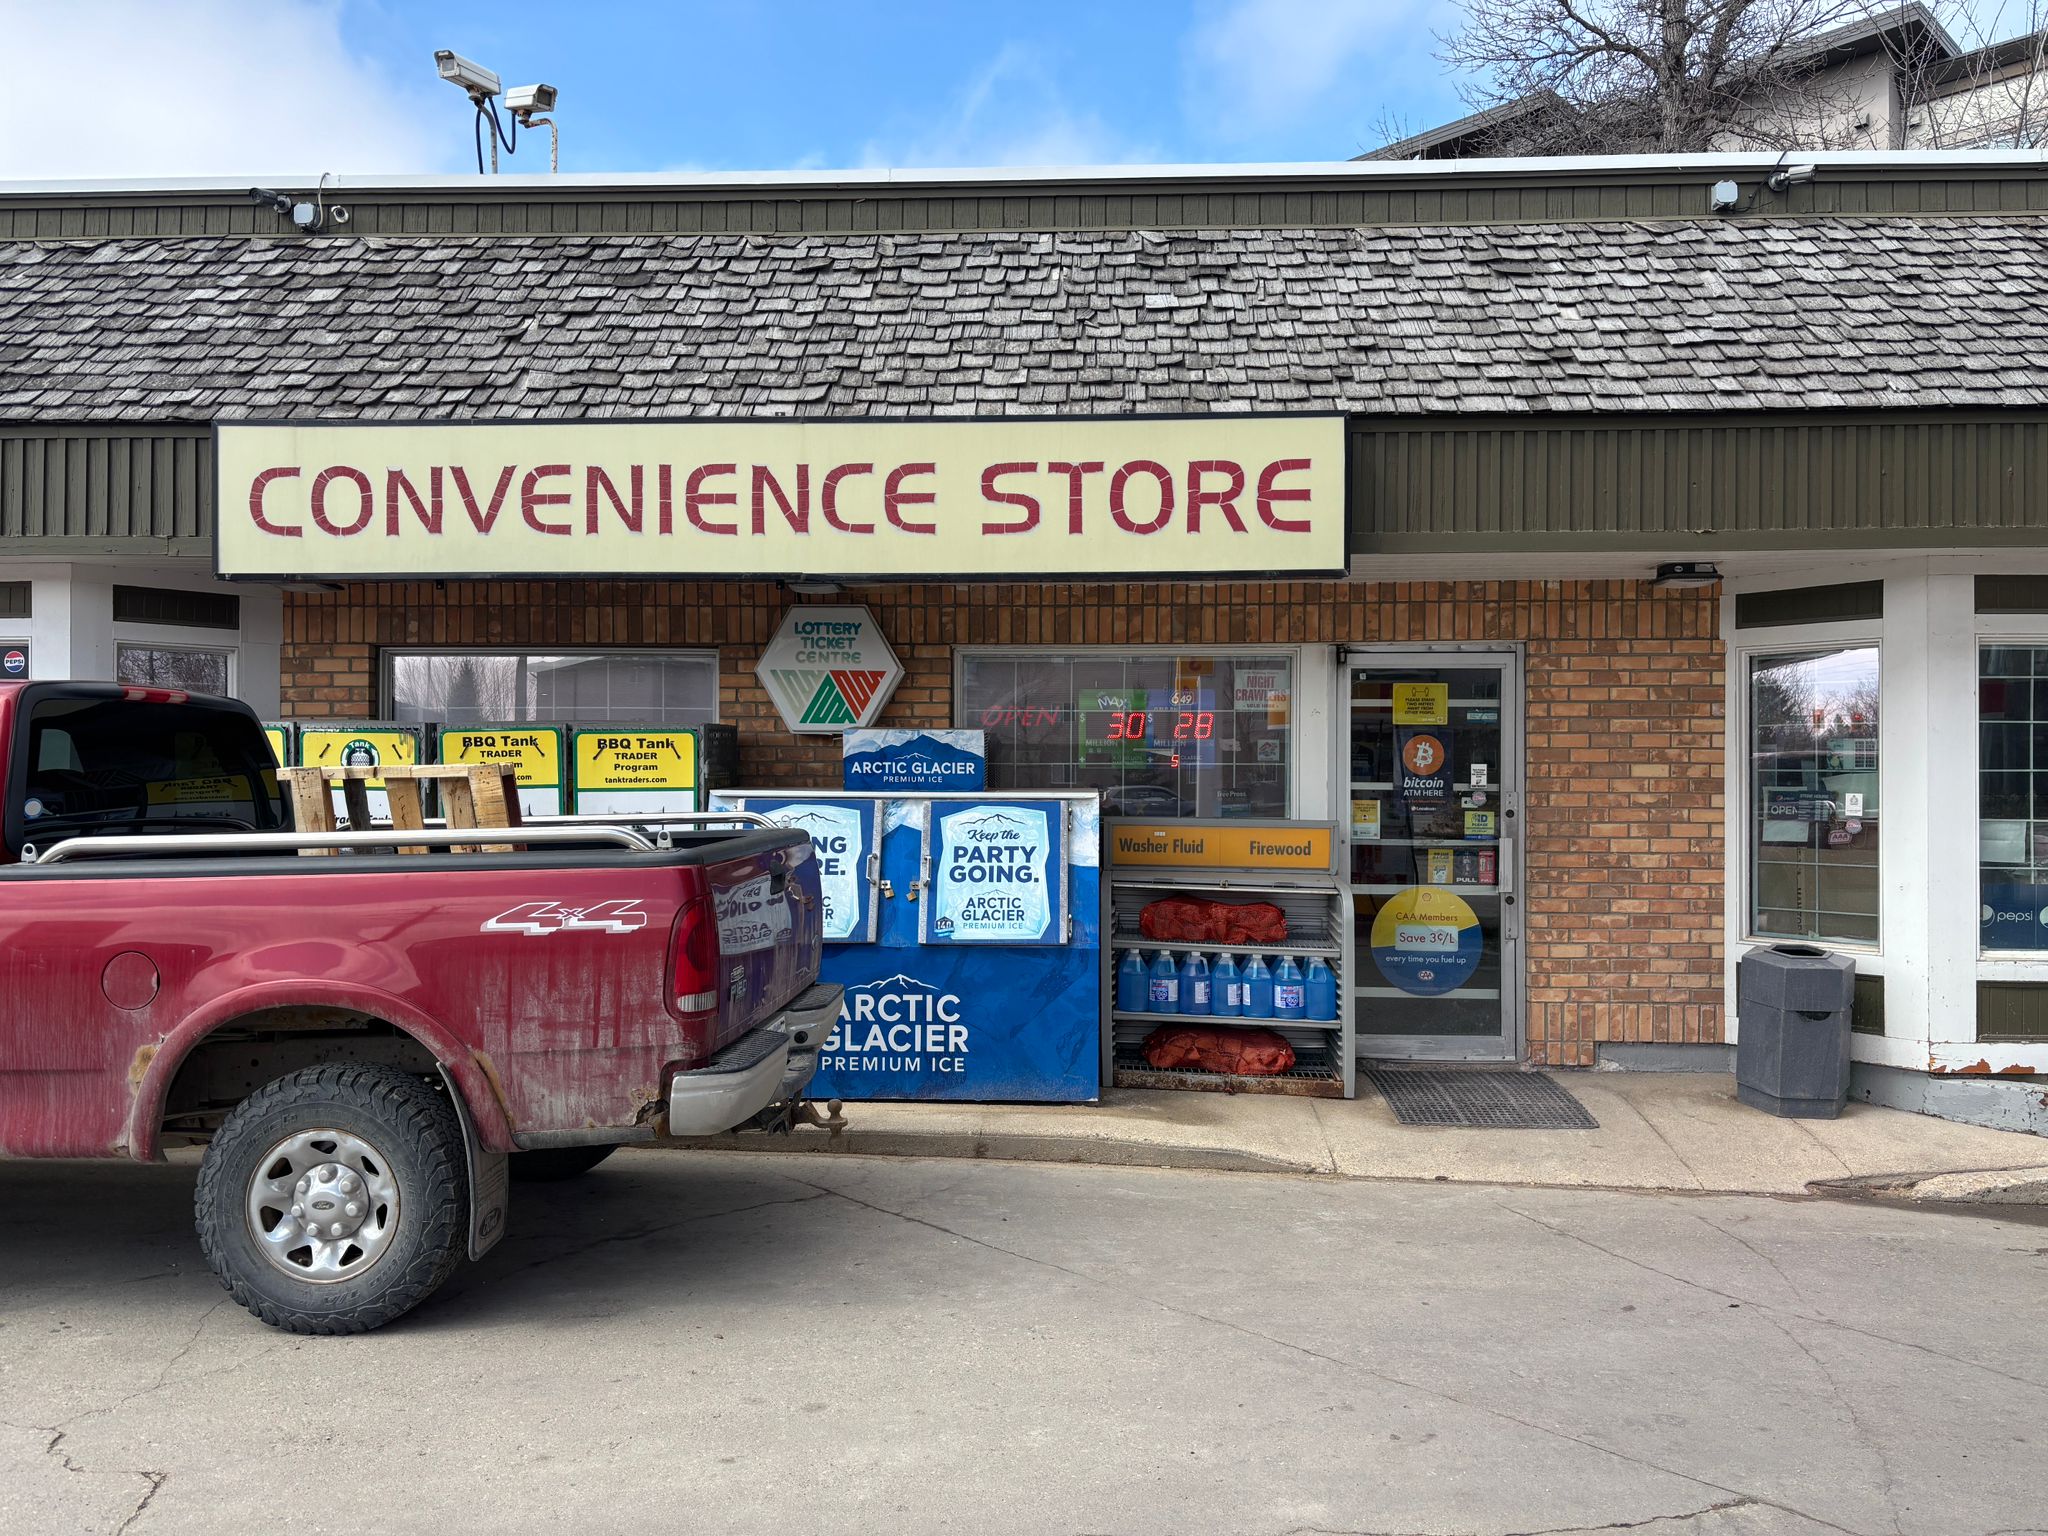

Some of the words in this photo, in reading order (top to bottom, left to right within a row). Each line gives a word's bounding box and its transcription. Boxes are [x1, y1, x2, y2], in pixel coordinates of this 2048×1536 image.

[248, 462, 937, 538] CONVENIENCE
[980, 457, 1312, 535] STORE
[794, 621, 863, 635] LOTTERY
[800, 636, 856, 650] TICKET
[795, 650, 863, 664] CENTRE
[1246, 675, 1276, 689] NIGHT
[981, 703, 1060, 728] OPEN
[1106, 711, 1146, 740] 30
[1173, 711, 1214, 740] 28
[350, 740, 371, 749] Tank
[461, 735, 496, 748] BBQ
[500, 734, 539, 748] Tank
[597, 738, 632, 750] BBQ
[636, 738, 675, 750] Tank
[480, 749, 522, 759] TRADER
[614, 752, 658, 760] TRADER
[1170, 754, 1179, 768] 5
[613, 763, 658, 772] Program
[851, 761, 908, 775] ARCTIC
[911, 761, 976, 775] GLACIER
[604, 776, 668, 785] tanktraders.com
[883, 776, 925, 784] PREMIUM
[928, 776, 944, 784] ICE
[1403, 776, 1444, 788] bitcoin
[1403, 789, 1421, 797] ATM
[1422, 789, 1444, 797] HERE
[967, 829, 1001, 842] Keep
[1000, 829, 1021, 841] the
[1119, 838, 1169, 853] Washer
[1172, 838, 1204, 854] Fluid
[1249, 840, 1312, 856] Firewood
[953, 845, 1038, 864] PARTY
[949, 864, 1040, 884] GOING.
[965, 897, 1022, 909] ARCTIC
[480, 899, 648, 937] 4x4
[961, 909, 1025, 921] GLACIER
[1395, 911, 1418, 921] CAA
[1419, 912, 1459, 922] Members
[1997, 910, 2033, 923] pepsi
[962, 922, 1005, 930] PREMIUM
[1008, 922, 1024, 930] ICE
[1399, 931, 1426, 943] Save
[1429, 932, 1456, 946] 3¢/L
[1385, 955, 1406, 965] every
[1407, 954, 1424, 963] time
[1425, 956, 1440, 965] you
[1440, 954, 1455, 964] fuel
[1456, 957, 1467, 966] up
[821, 1023, 969, 1053] GLACIER
[821, 1056, 921, 1072] PREMIUM
[931, 1057, 965, 1072] ICE
